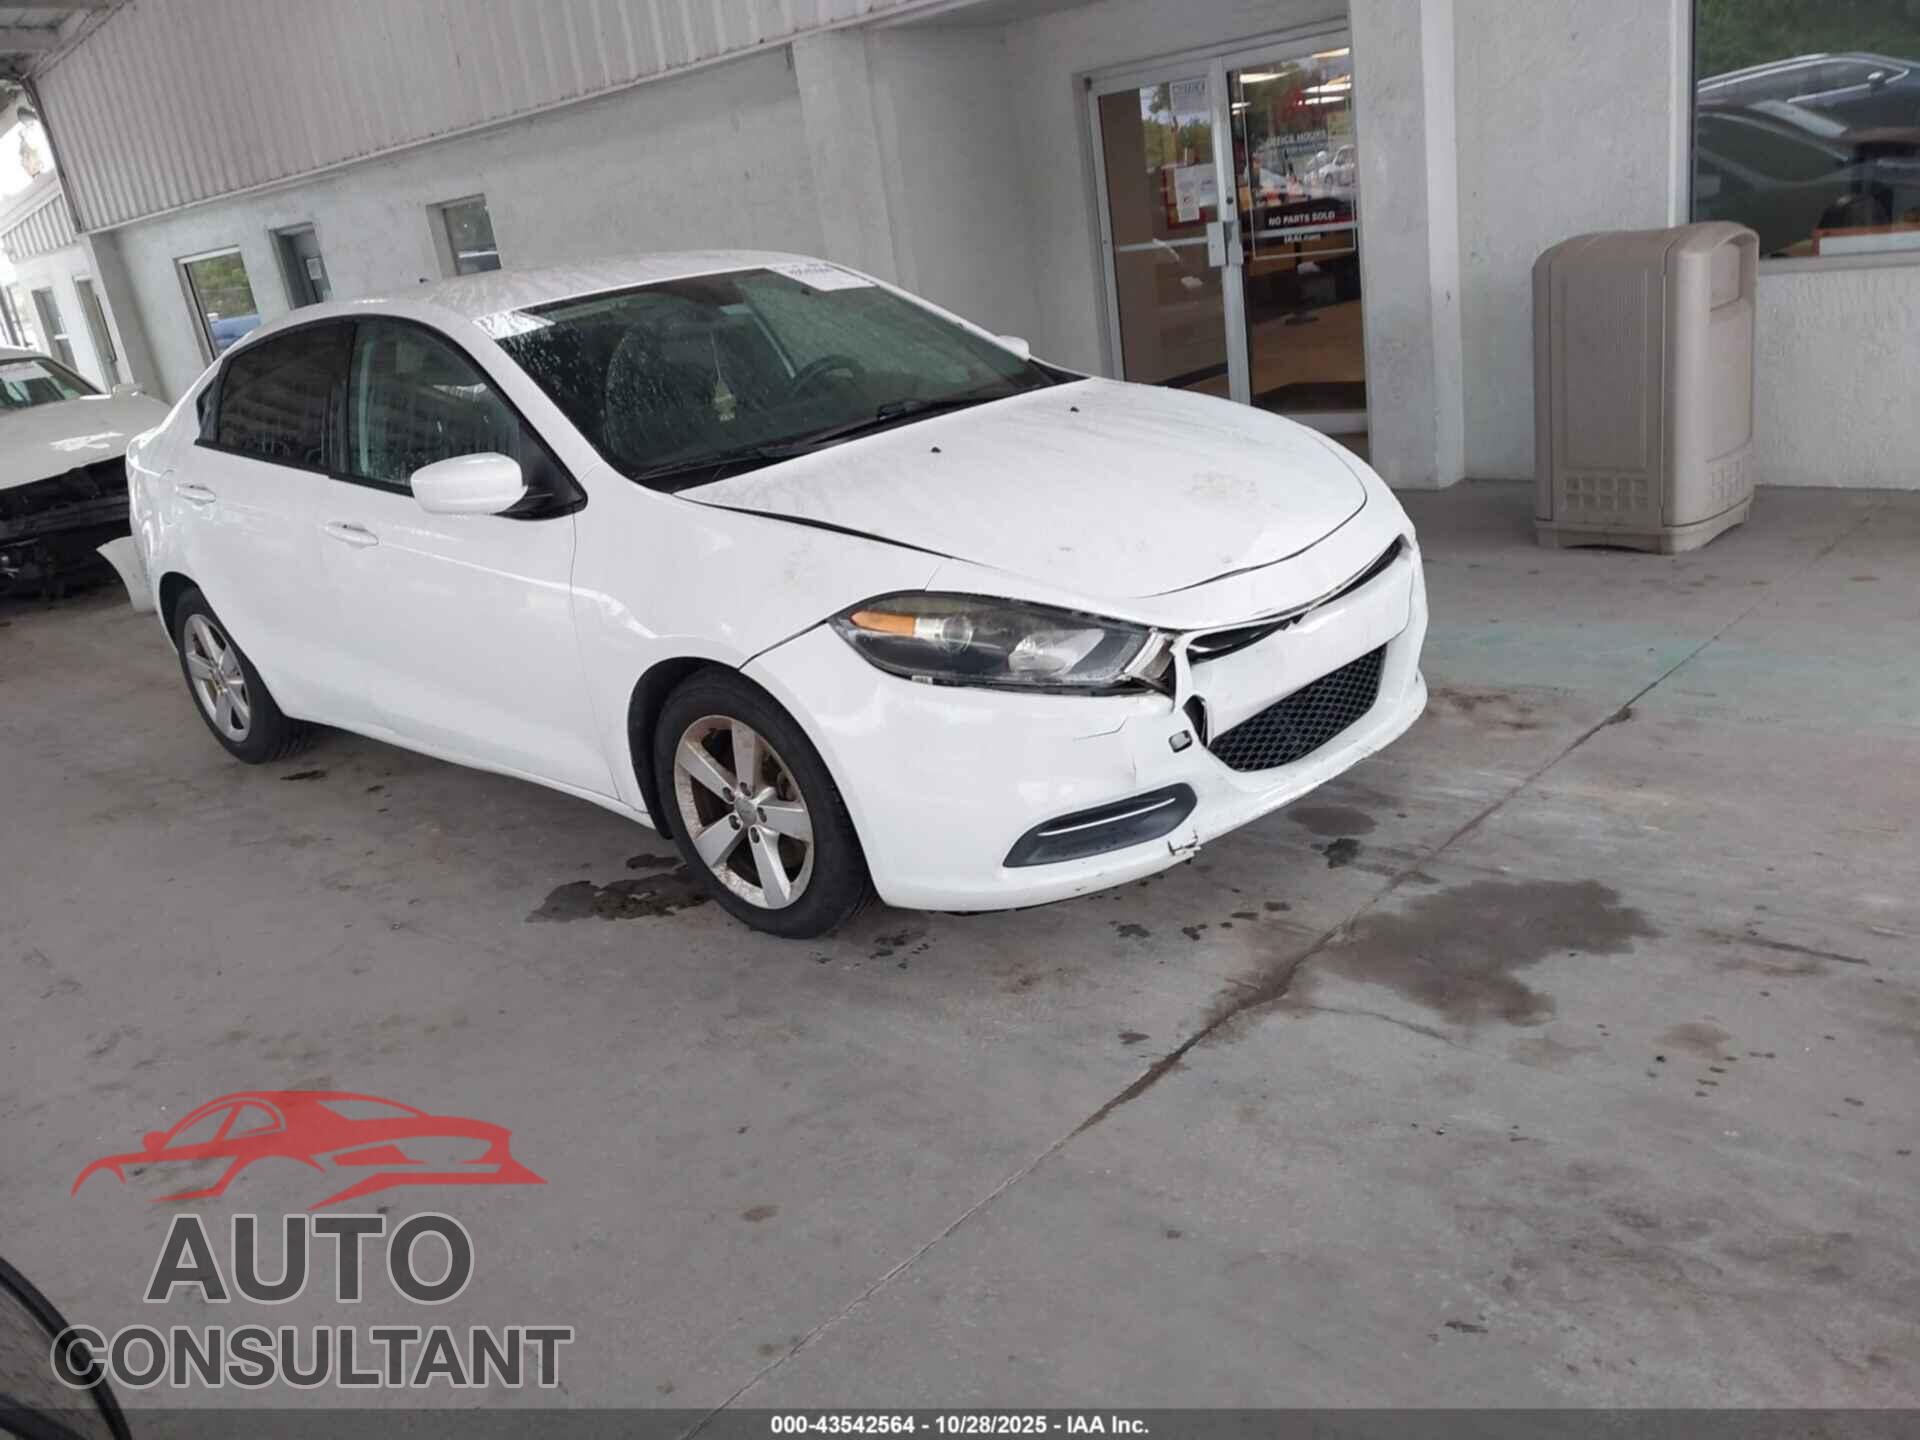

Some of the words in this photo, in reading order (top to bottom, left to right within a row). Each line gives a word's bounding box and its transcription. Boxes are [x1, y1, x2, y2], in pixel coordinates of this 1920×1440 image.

[1268, 217, 1281, 226] NO
[1283, 213, 1310, 225] PARTS
[1312, 210, 1336, 221] SOLD
